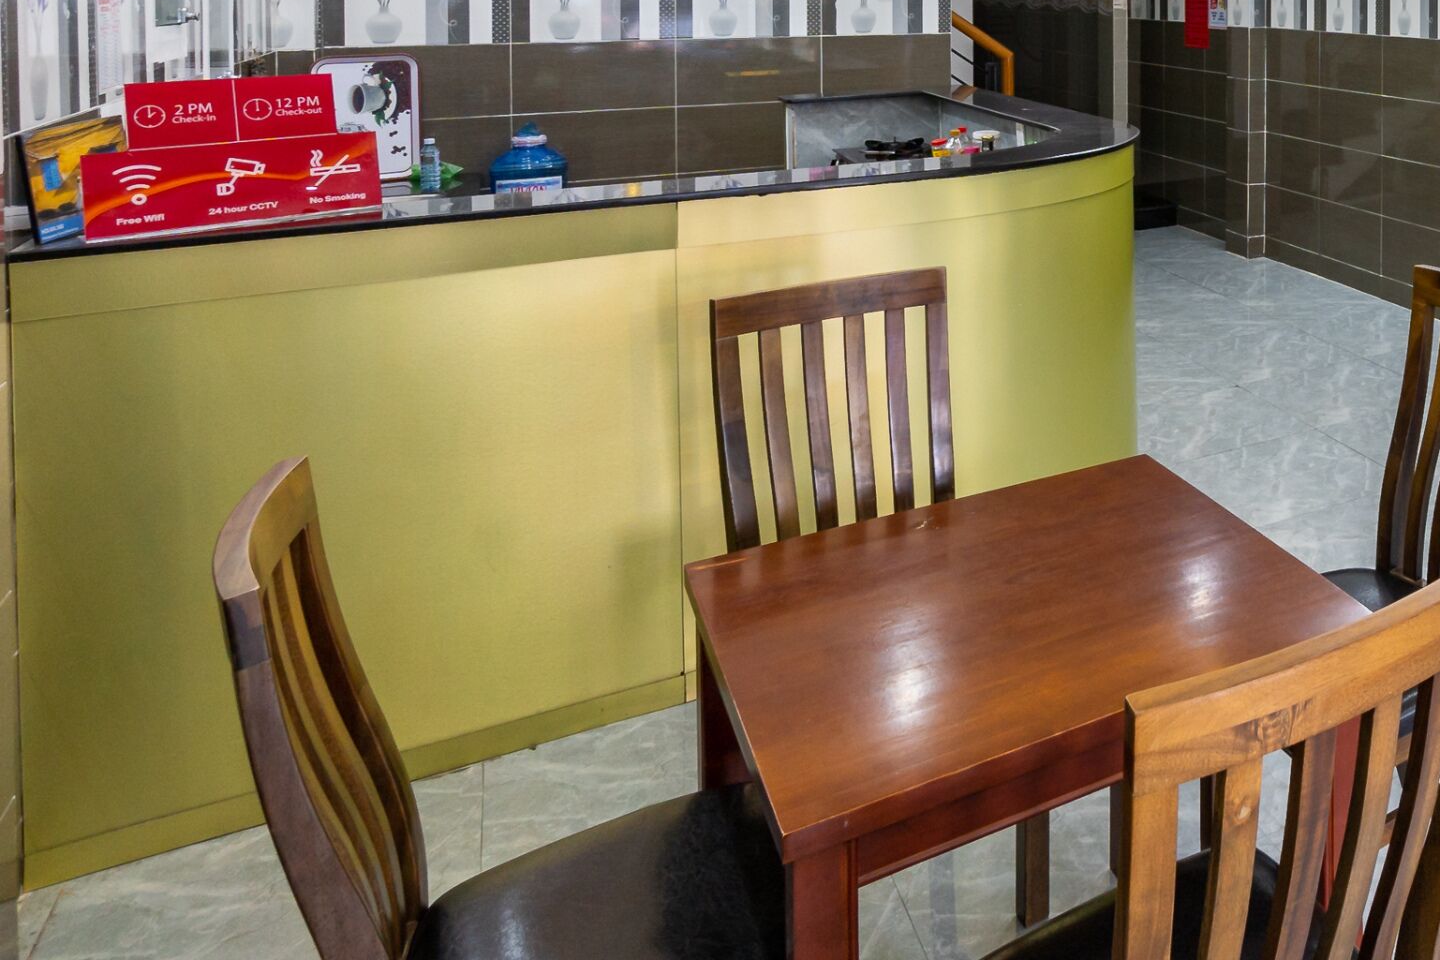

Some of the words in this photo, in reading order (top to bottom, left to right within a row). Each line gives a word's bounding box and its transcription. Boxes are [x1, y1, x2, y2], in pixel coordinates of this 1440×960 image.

[275, 98, 292, 108] 12
[296, 95, 320, 107] PM
[174, 104, 184, 115] 2
[188, 102, 213, 114] PM
[275, 107, 322, 117] Check-out
[309, 196, 323, 204] No
[324, 192, 366, 202] Smoking
[208, 207, 222, 215] 24
[223, 205, 247, 214] hour
[249, 201, 278, 211] CCTV
[116, 217, 142, 226] Free
